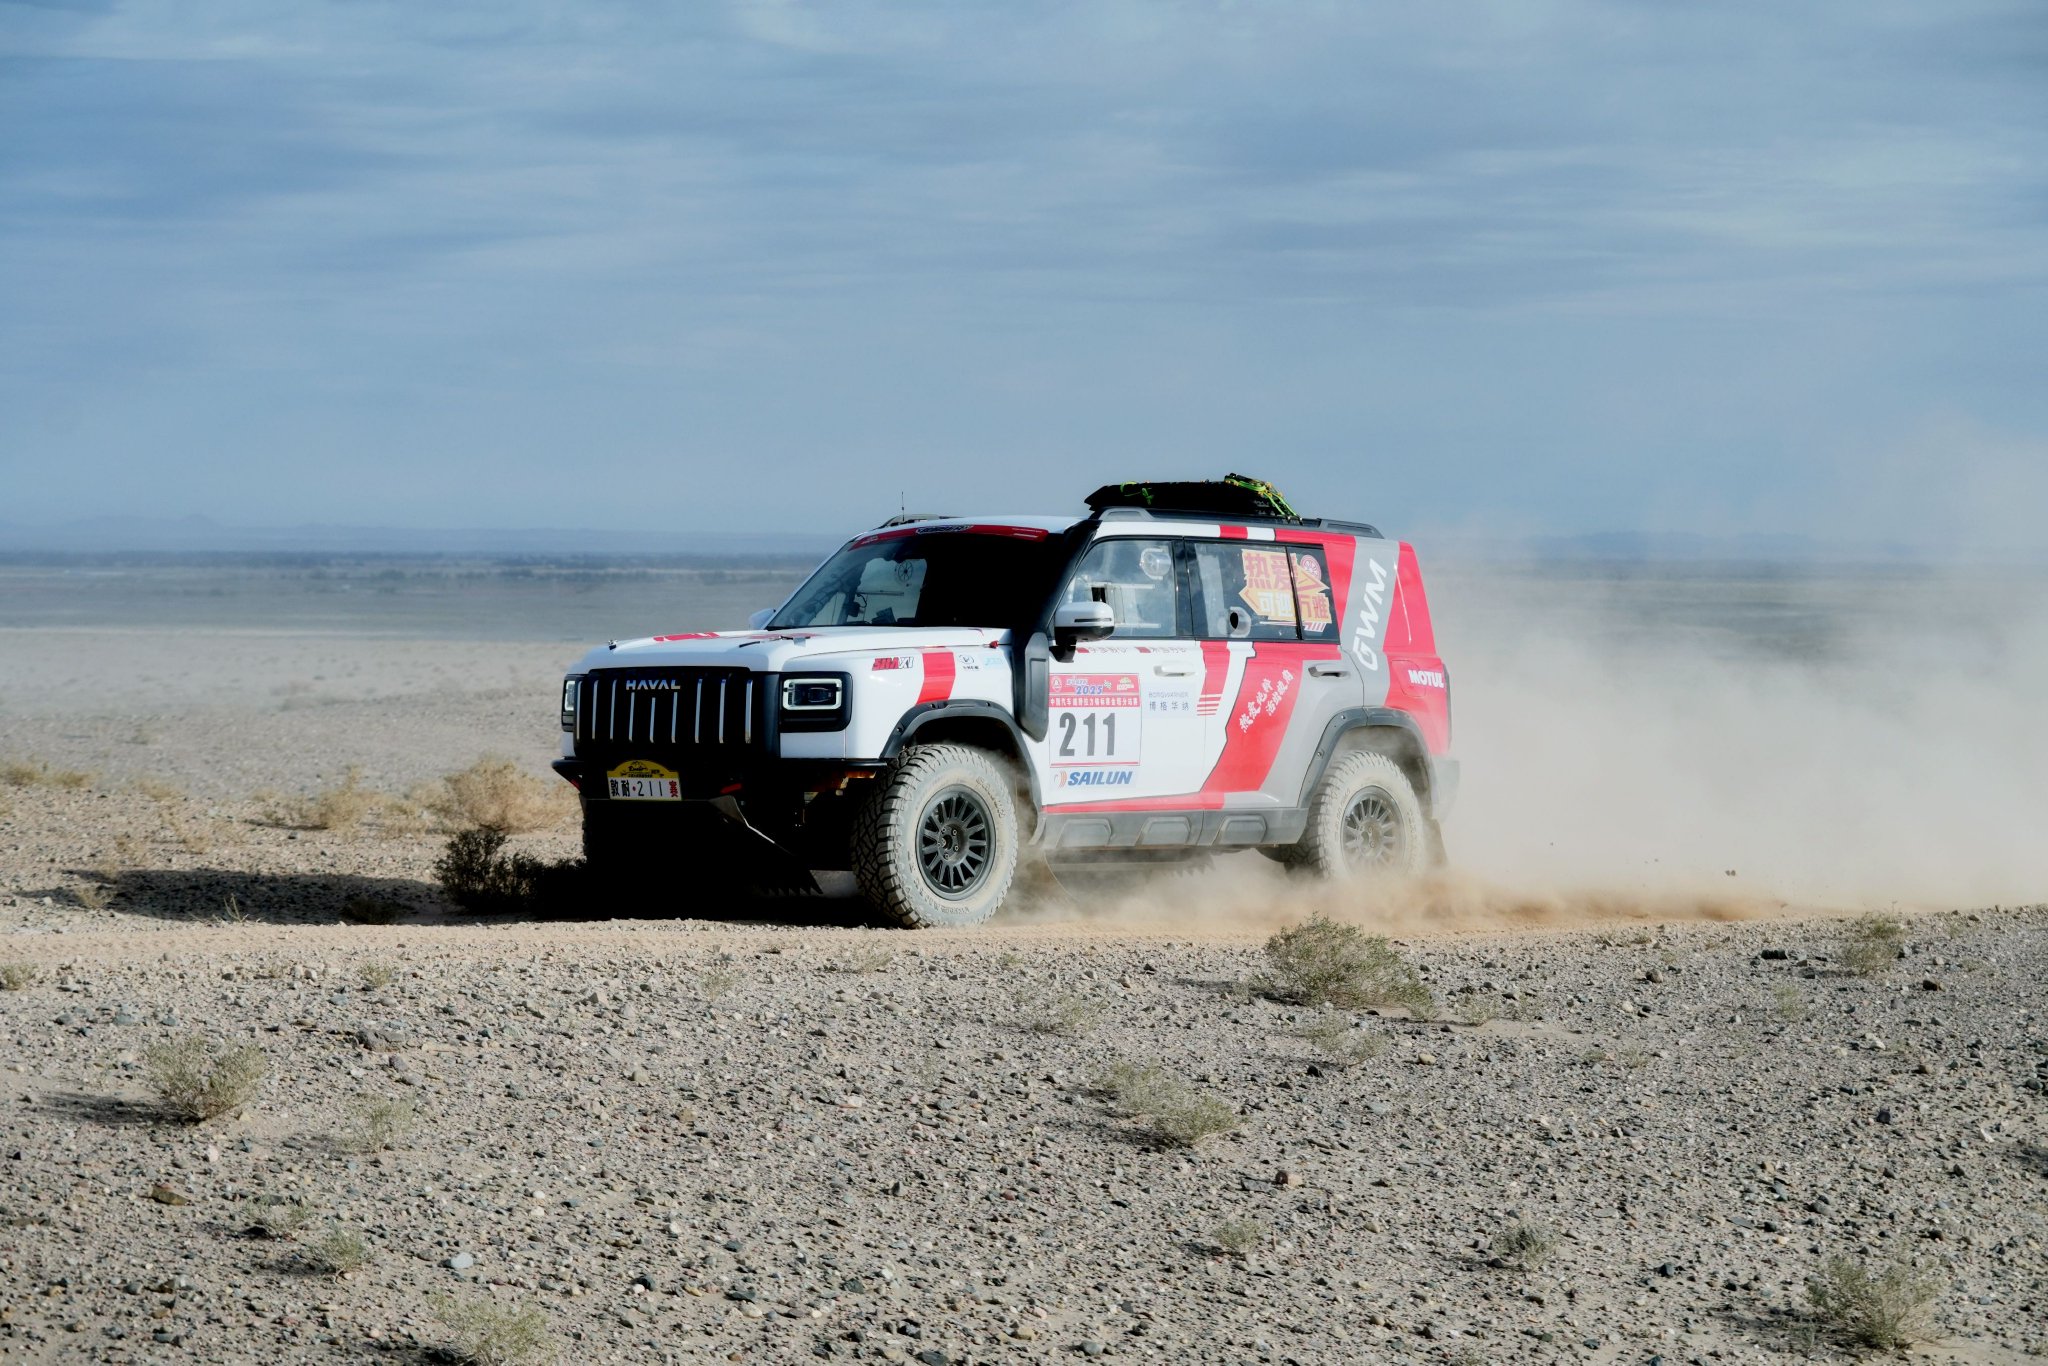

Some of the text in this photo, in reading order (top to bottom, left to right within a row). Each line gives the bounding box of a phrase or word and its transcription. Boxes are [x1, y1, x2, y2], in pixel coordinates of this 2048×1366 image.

[1244, 552, 1298, 590] 热爱
[1352, 558, 1387, 671] GWM
[626, 679, 681, 691] HAVAL
[1408, 669, 1445, 688] MOTUL
[1075, 685, 1104, 695] 2025
[1149, 701, 1189, 711] 博格华纳
[1059, 712, 1116, 757] 211
[1067, 771, 1133, 786] SAILUN
